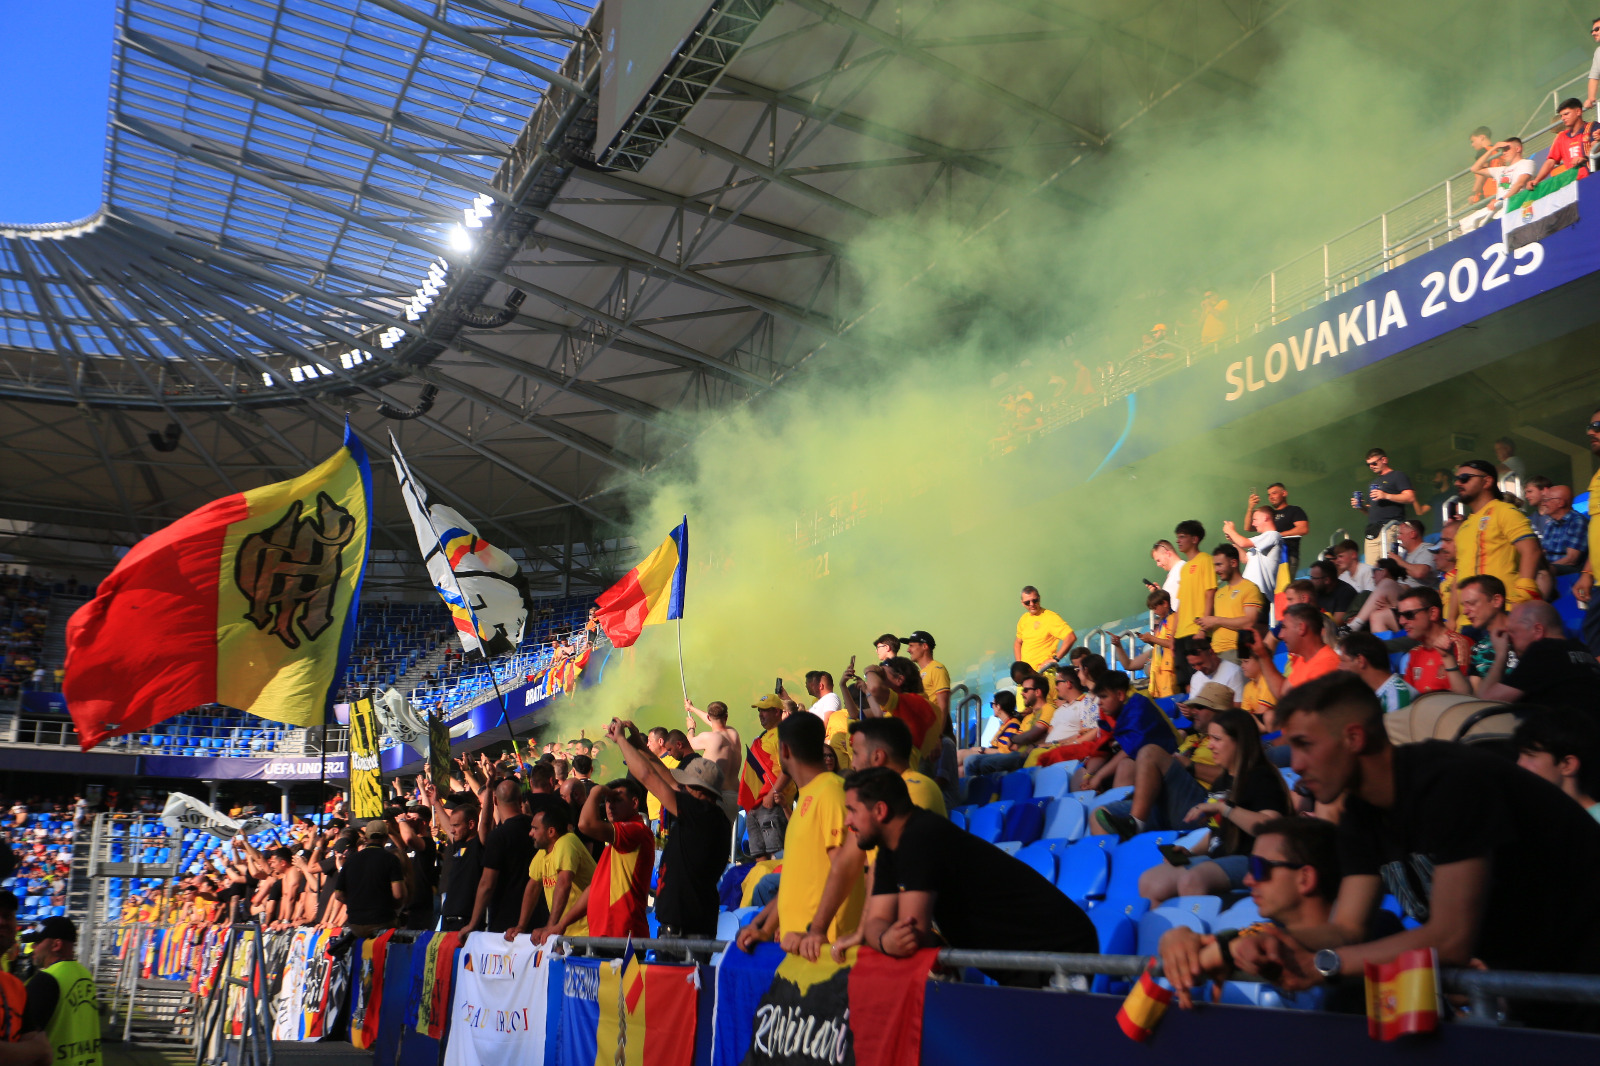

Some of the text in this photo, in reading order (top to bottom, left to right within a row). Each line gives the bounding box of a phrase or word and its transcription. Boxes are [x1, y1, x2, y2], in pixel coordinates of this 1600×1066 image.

[1225, 241, 1545, 402] SLOVAKIA 2025
[263, 763, 297, 775] UEFA
